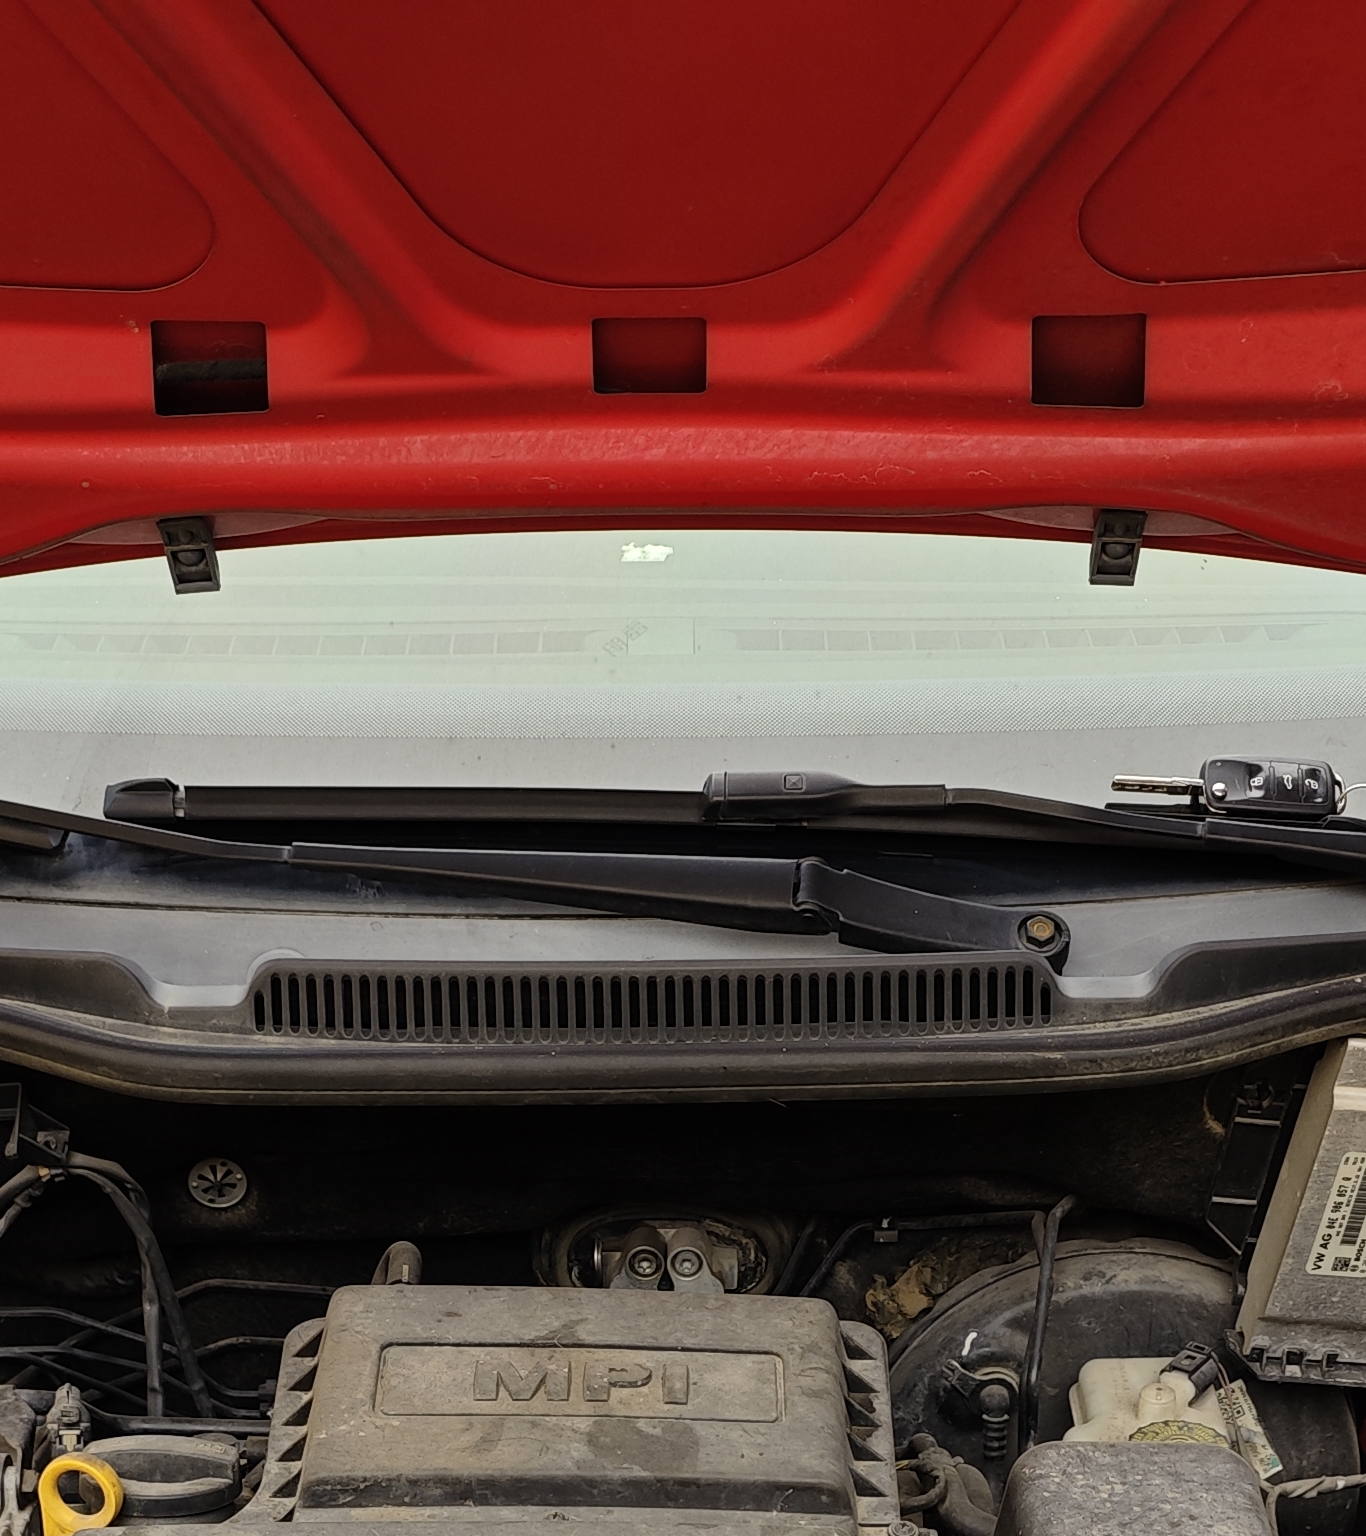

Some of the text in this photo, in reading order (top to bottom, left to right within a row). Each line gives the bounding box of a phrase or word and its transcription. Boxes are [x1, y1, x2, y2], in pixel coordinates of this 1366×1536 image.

[1311, 1252, 1326, 1271] VW
[1319, 1233, 1333, 1250] AG
[1336, 1184, 1350, 1198] 057
[1354, 1239, 1366, 1262] BOSCH
[474, 1359, 690, 1405] MPI
